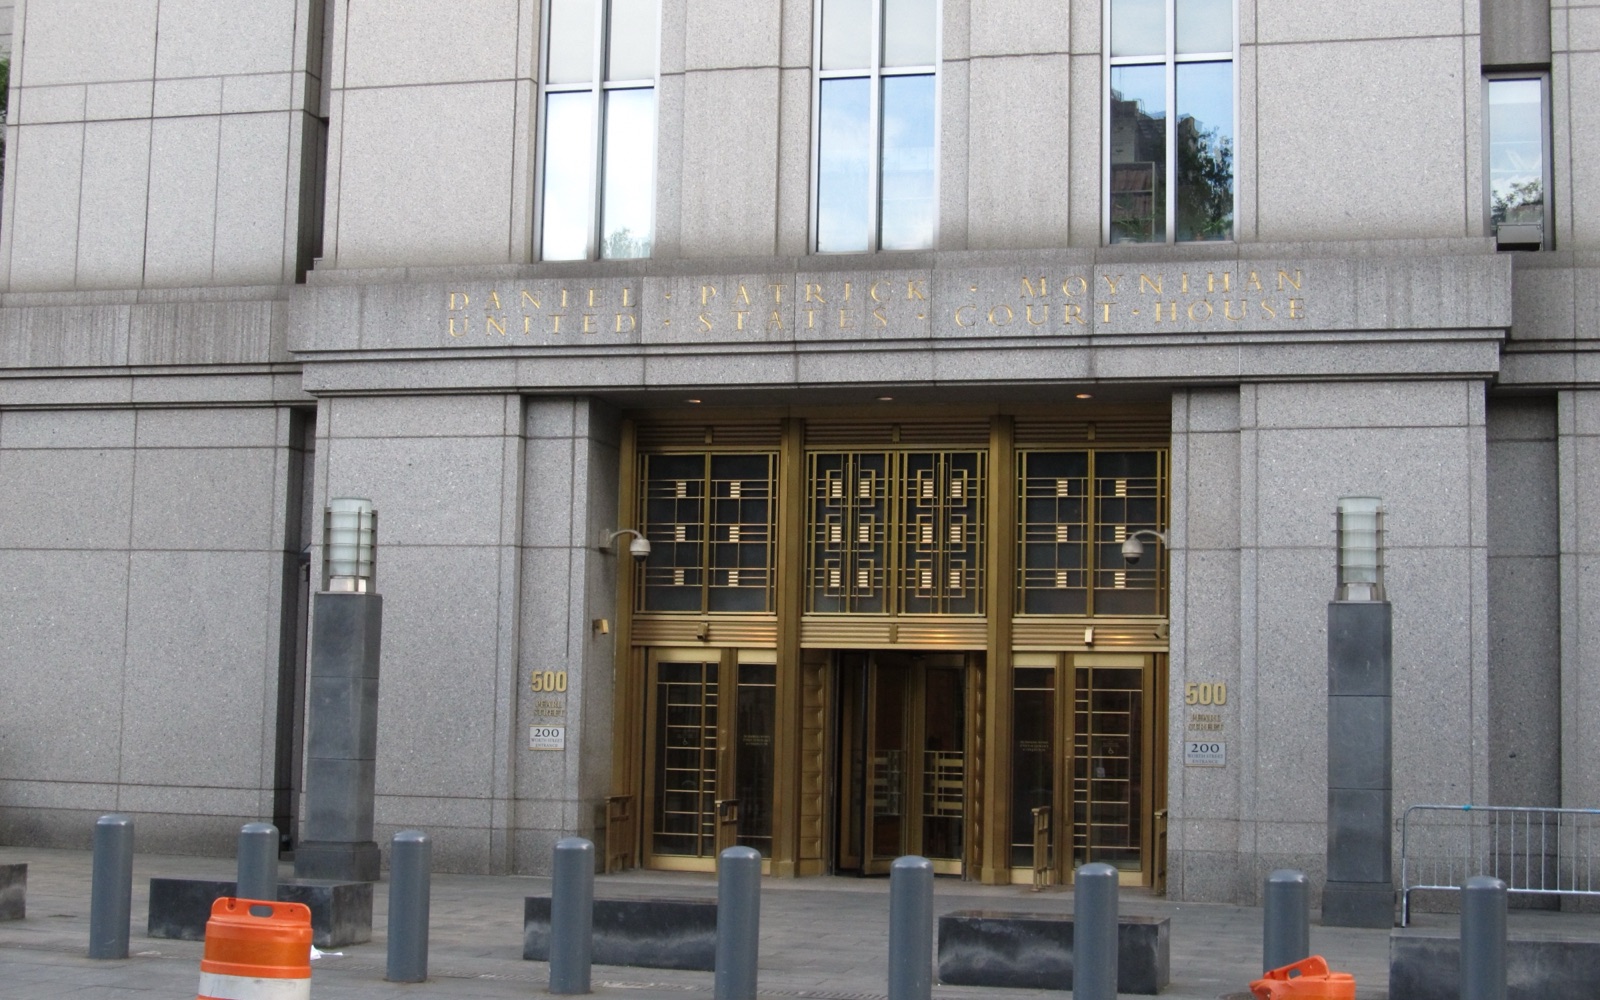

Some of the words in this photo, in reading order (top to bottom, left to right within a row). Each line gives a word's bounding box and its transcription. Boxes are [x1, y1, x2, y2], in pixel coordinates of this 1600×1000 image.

[448, 287, 638, 312] DANIEL
[700, 279, 927, 308] PATRICK
[1020, 268, 1304, 299] MOYNIHAN
[448, 313, 638, 339] UNITED
[698, 305, 888, 334] STATES
[954, 302, 1112, 328] COURT
[1154, 297, 1306, 324] HOUSE
[531, 670, 567, 692] 500
[1185, 682, 1227, 706] 500
[534, 728, 560, 738] 200
[1191, 743, 1220, 753] 200
